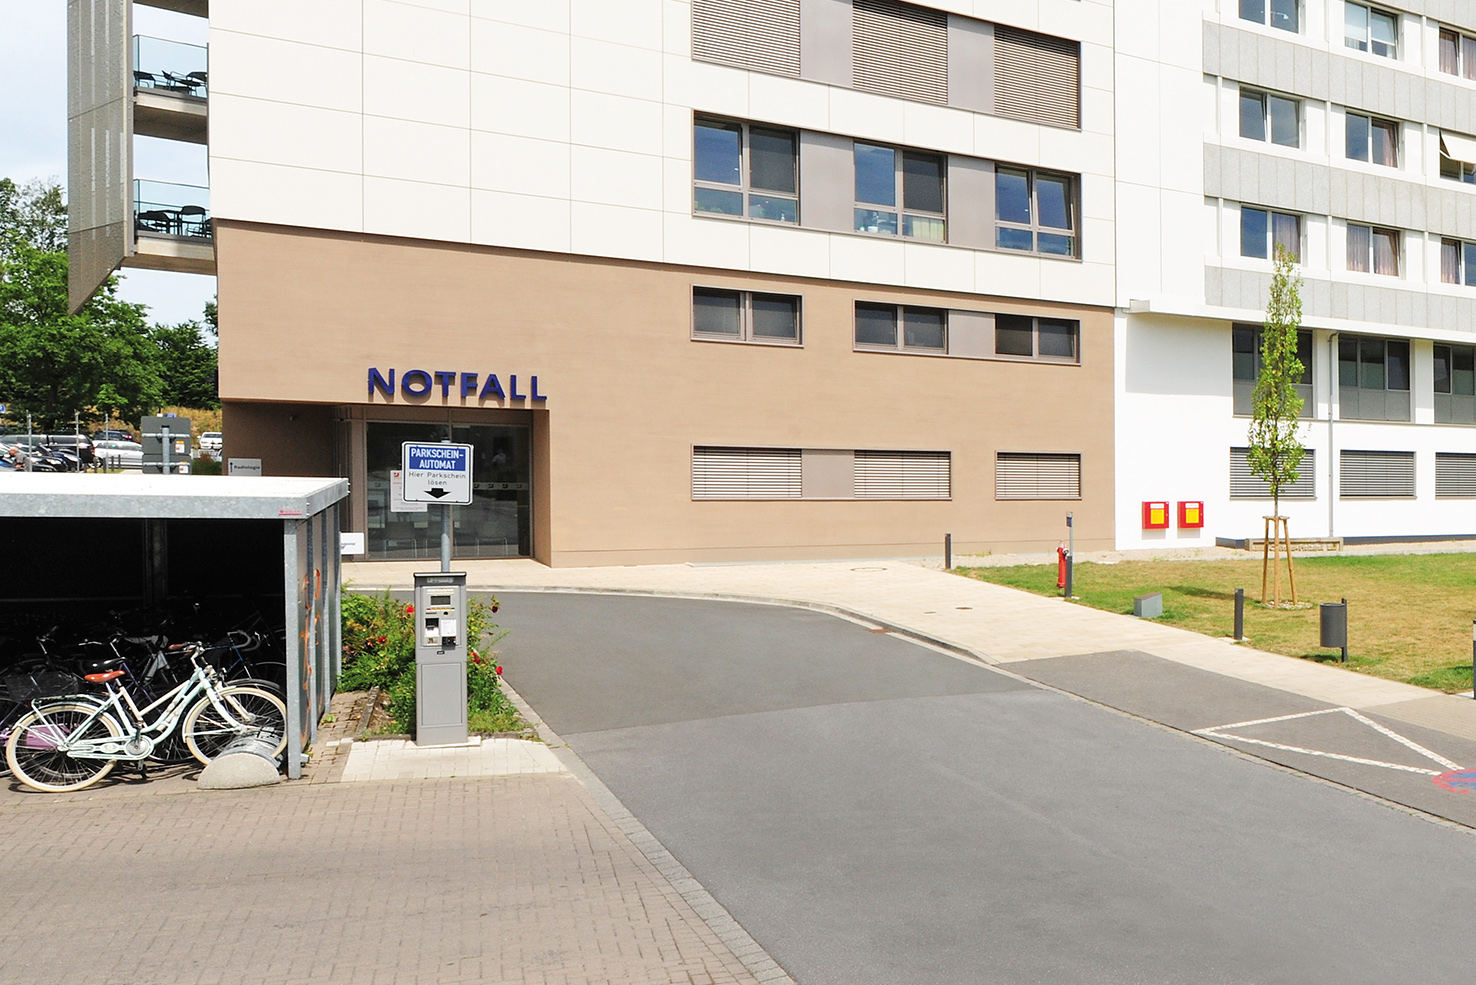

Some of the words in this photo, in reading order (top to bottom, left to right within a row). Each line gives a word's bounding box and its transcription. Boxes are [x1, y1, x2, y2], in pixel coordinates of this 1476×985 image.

[368, 367, 547, 400] NOTFALL
[411, 448, 464, 459] PARKSCHEIN-
[419, 459, 456, 470] AUTOMAT
